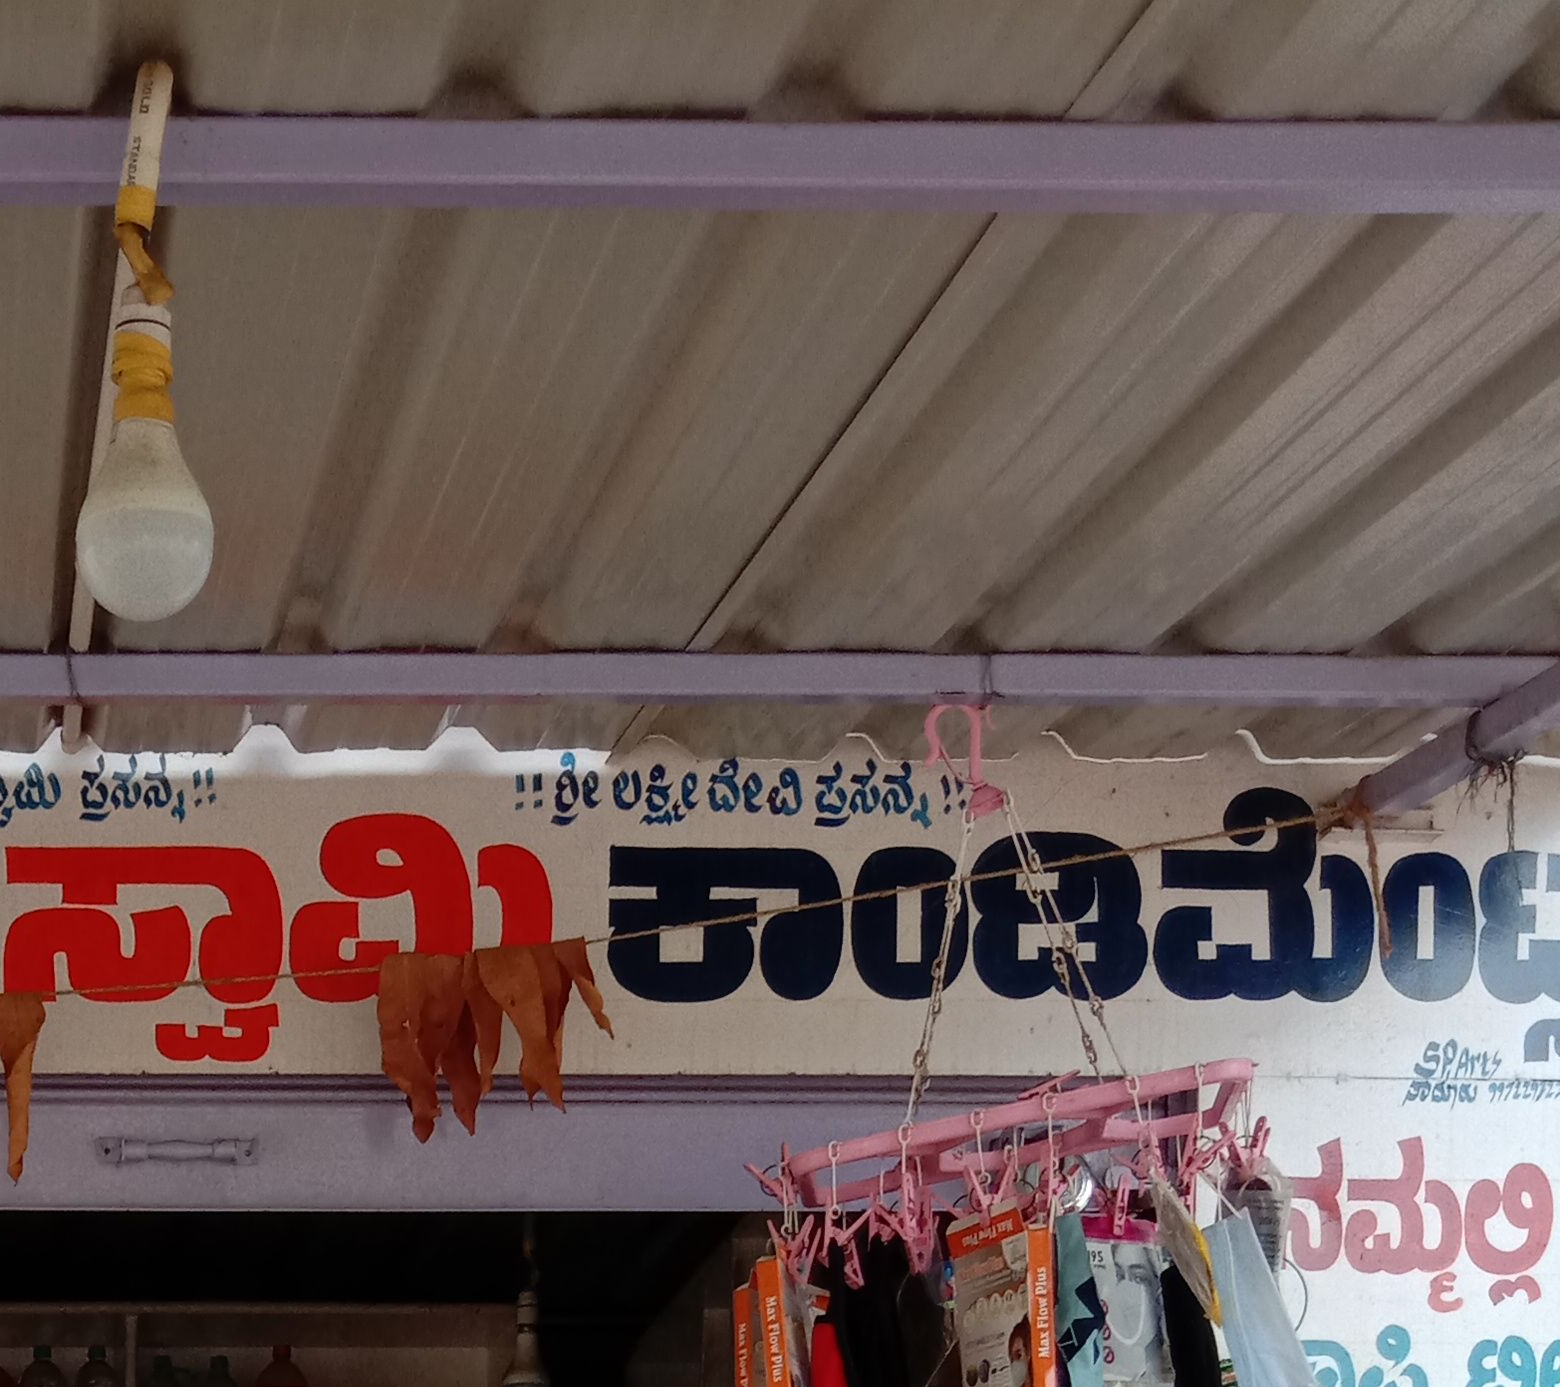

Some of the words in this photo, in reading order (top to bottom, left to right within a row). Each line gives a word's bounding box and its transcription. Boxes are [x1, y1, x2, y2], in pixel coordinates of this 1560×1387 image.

[1036, 1265, 1048, 1296] Plus
[764, 1296, 777, 1322] Max
[1035, 1299, 1049, 1332] Flow
[767, 1324, 780, 1353] Flow
[1036, 1333, 1049, 1359] Max
[771, 1355, 783, 1383] Plus
